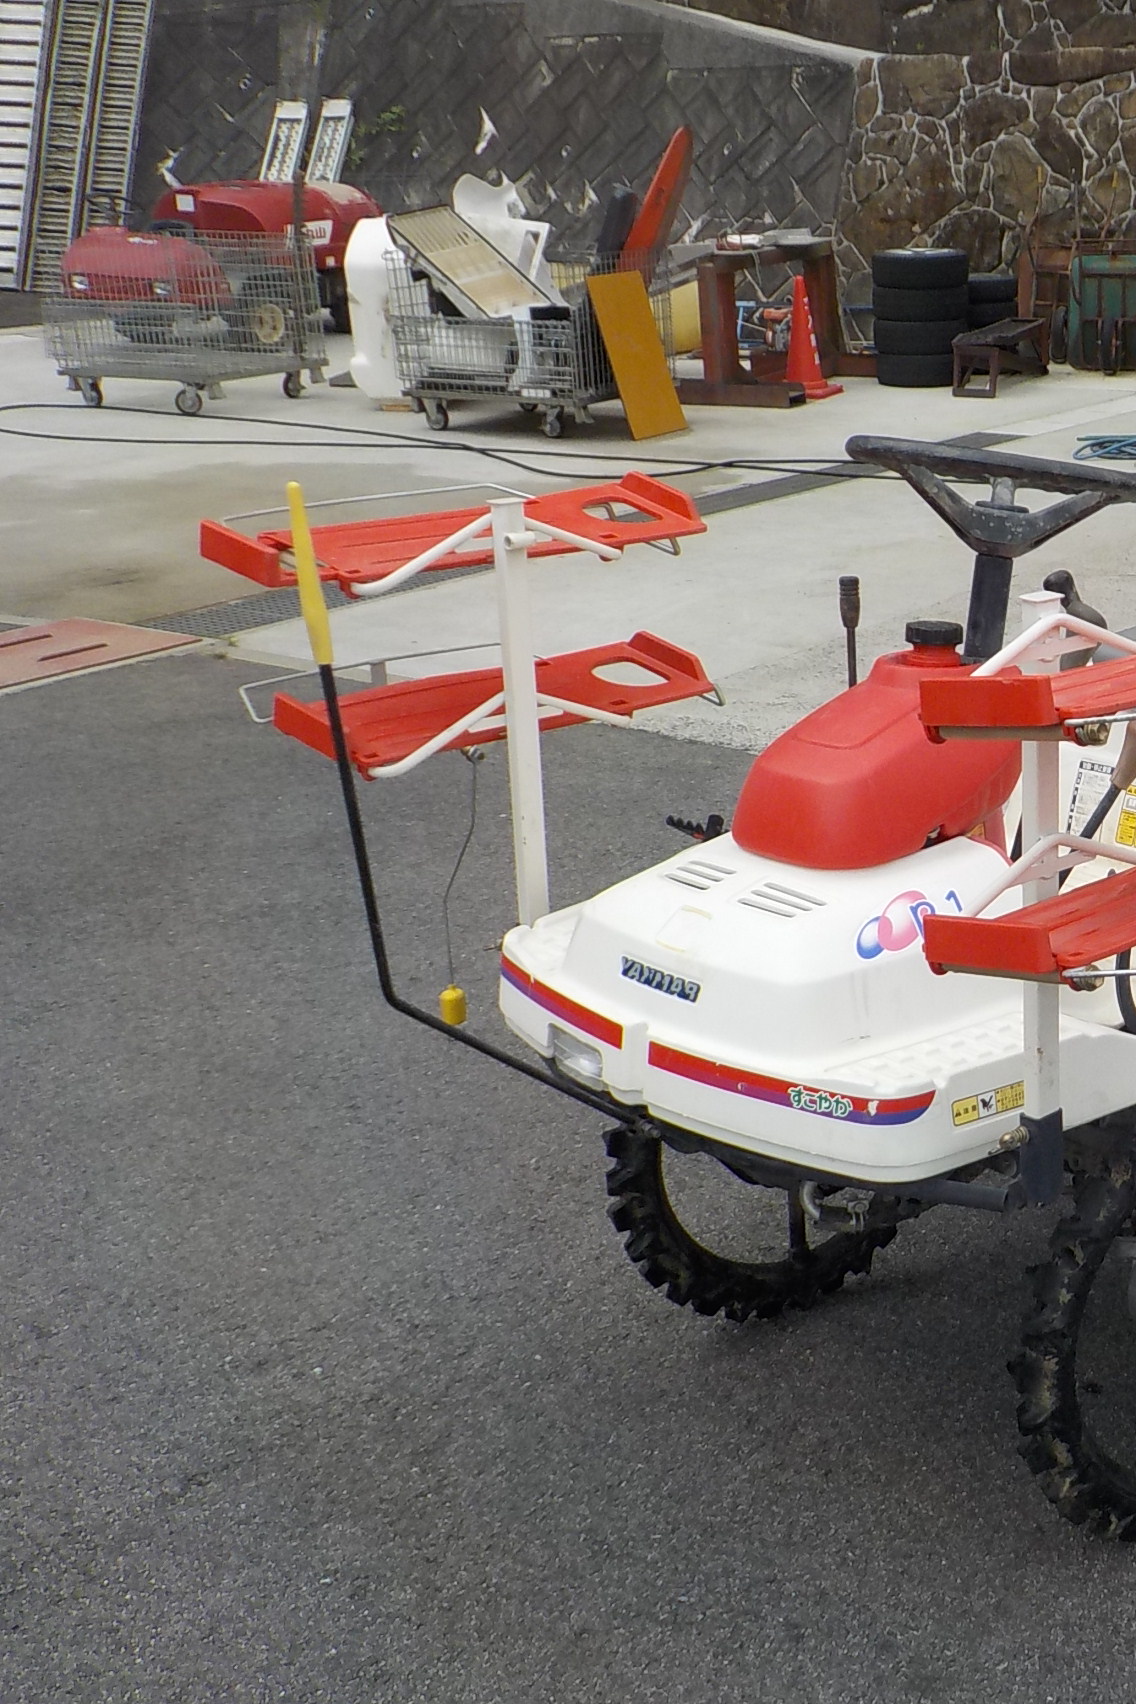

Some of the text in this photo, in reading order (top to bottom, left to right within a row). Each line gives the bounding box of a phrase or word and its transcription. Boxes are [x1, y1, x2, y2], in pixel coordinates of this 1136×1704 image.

[621, 956, 701, 1002] YANMAR
[789, 1087, 852, 1116] すこやか
